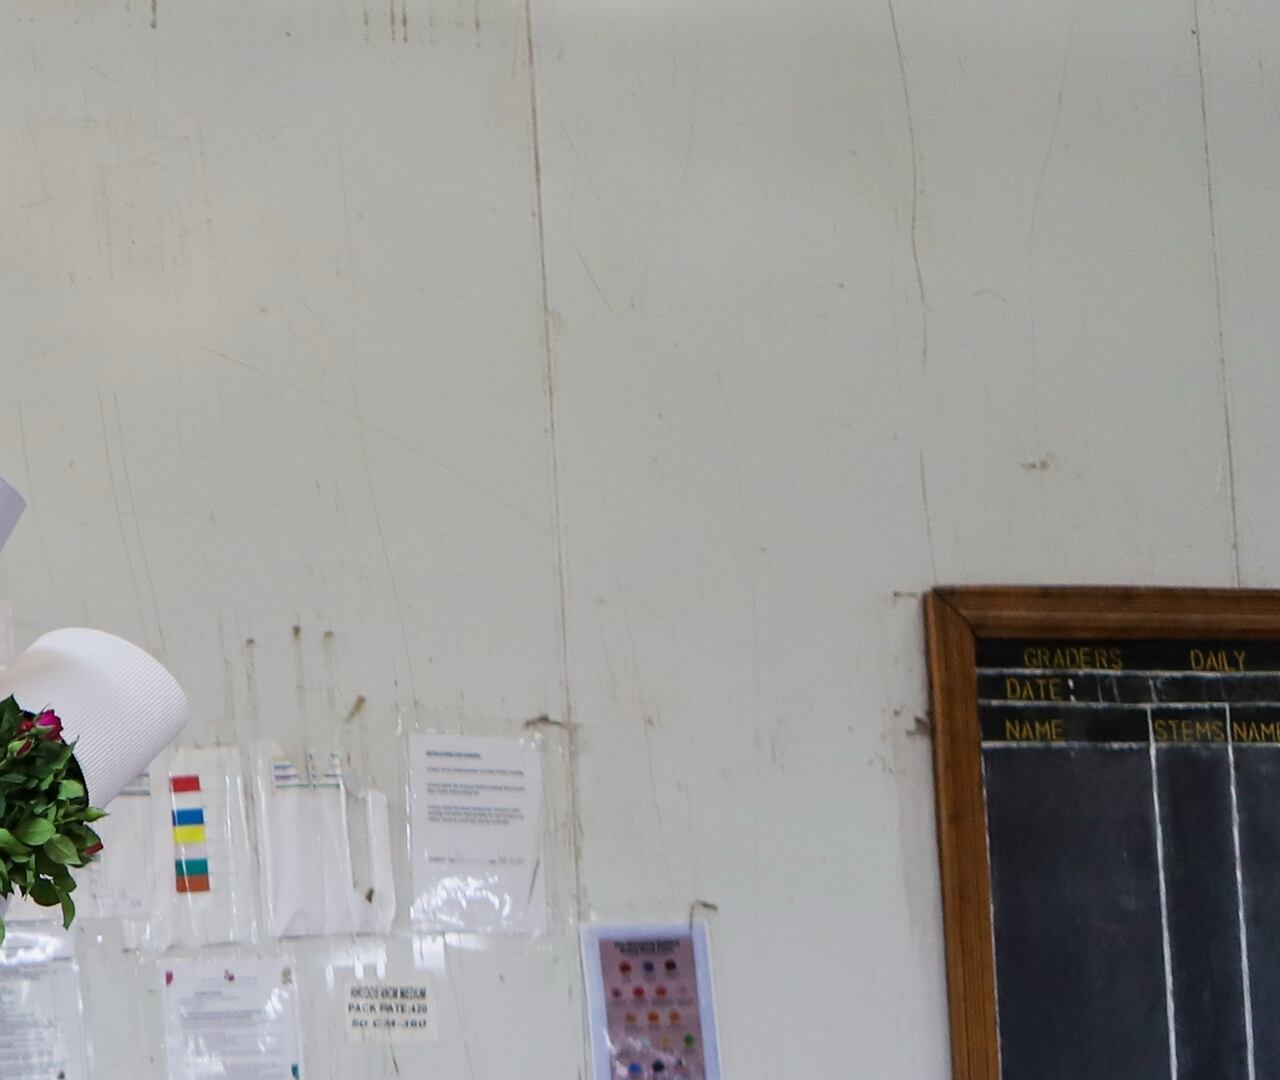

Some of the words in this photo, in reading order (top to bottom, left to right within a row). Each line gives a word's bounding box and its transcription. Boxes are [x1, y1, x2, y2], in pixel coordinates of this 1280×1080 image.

[1023, 647, 1123, 670] GRADERS
[1190, 649, 1247, 672] DAILY
[1004, 718, 1065, 741] NAME
[1153, 719, 1226, 742] STEMS
